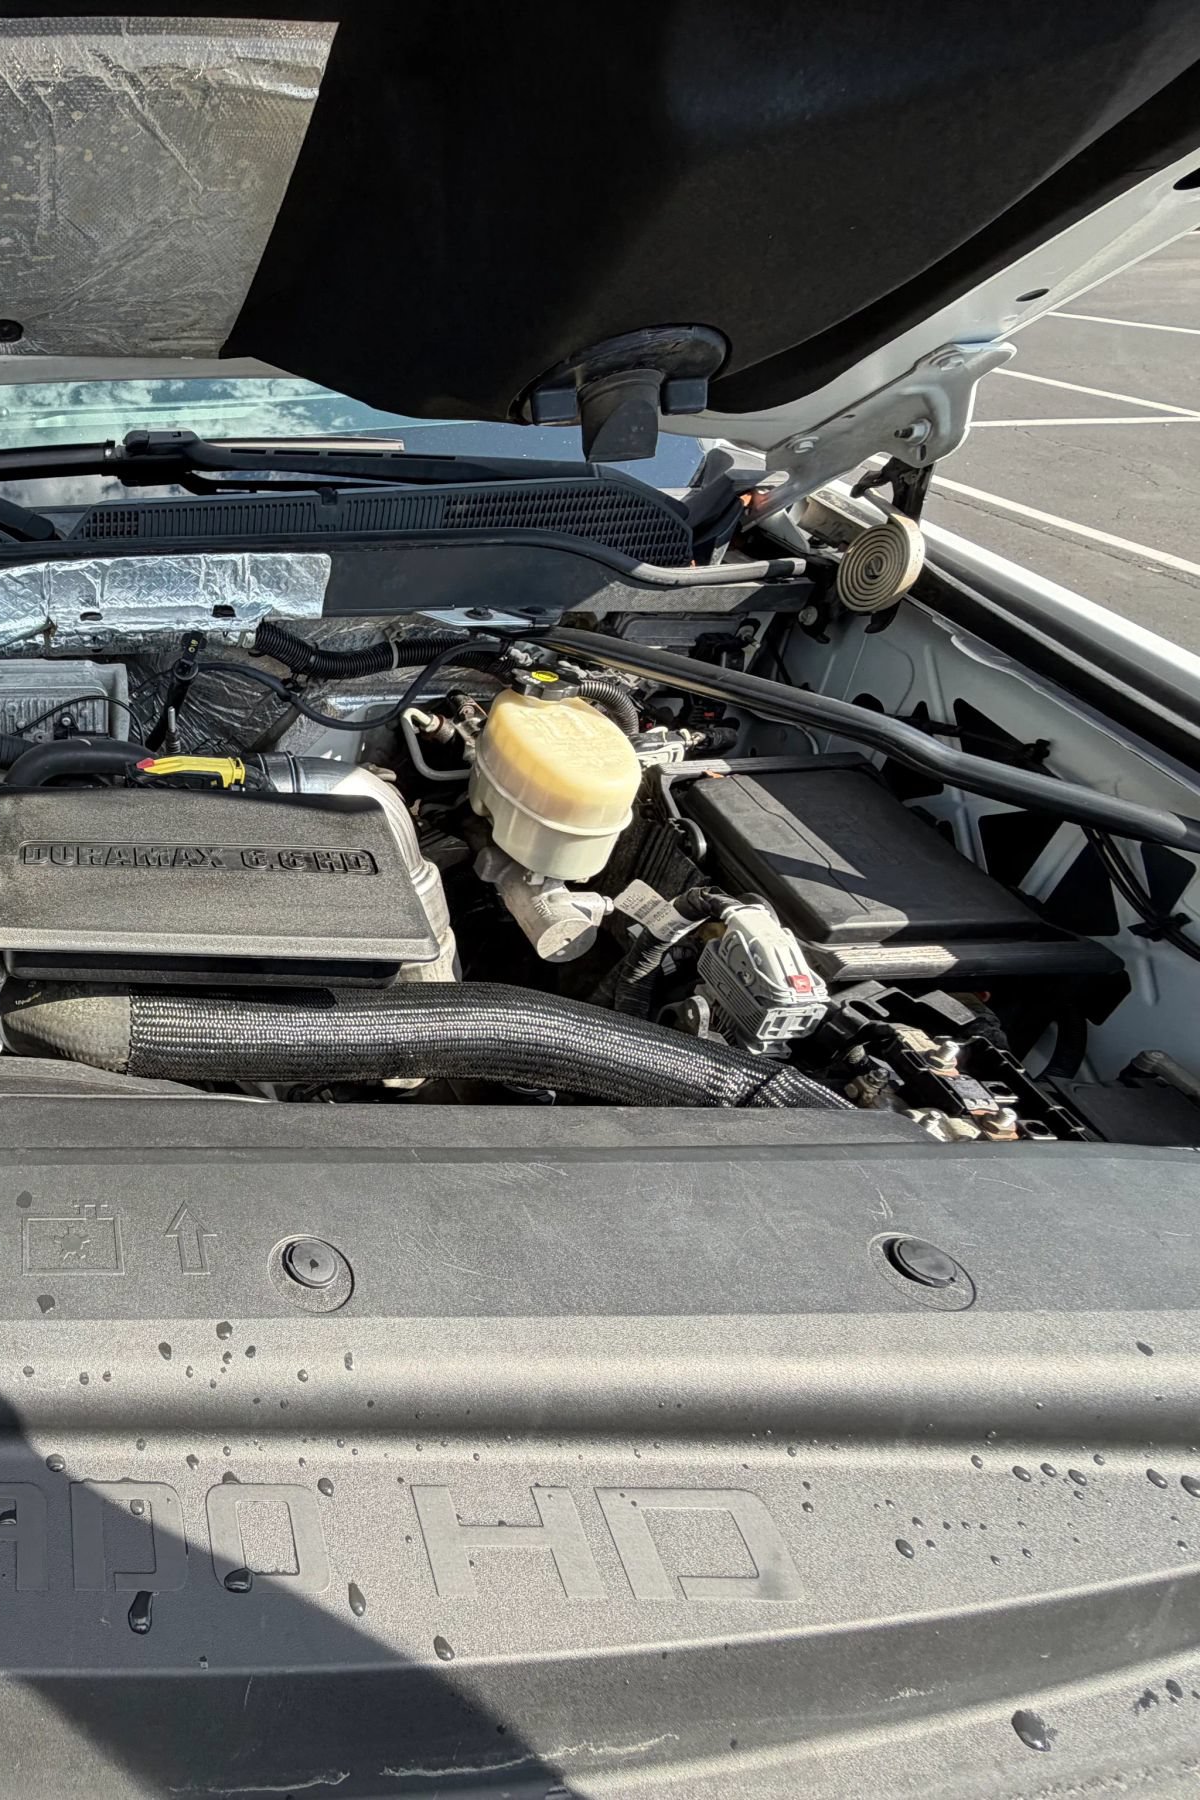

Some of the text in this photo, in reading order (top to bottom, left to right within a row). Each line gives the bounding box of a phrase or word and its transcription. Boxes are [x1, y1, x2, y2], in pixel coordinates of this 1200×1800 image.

[22, 846, 374, 872] DURAMAX 6.6 HD
[410, 1484, 804, 1601] HD
